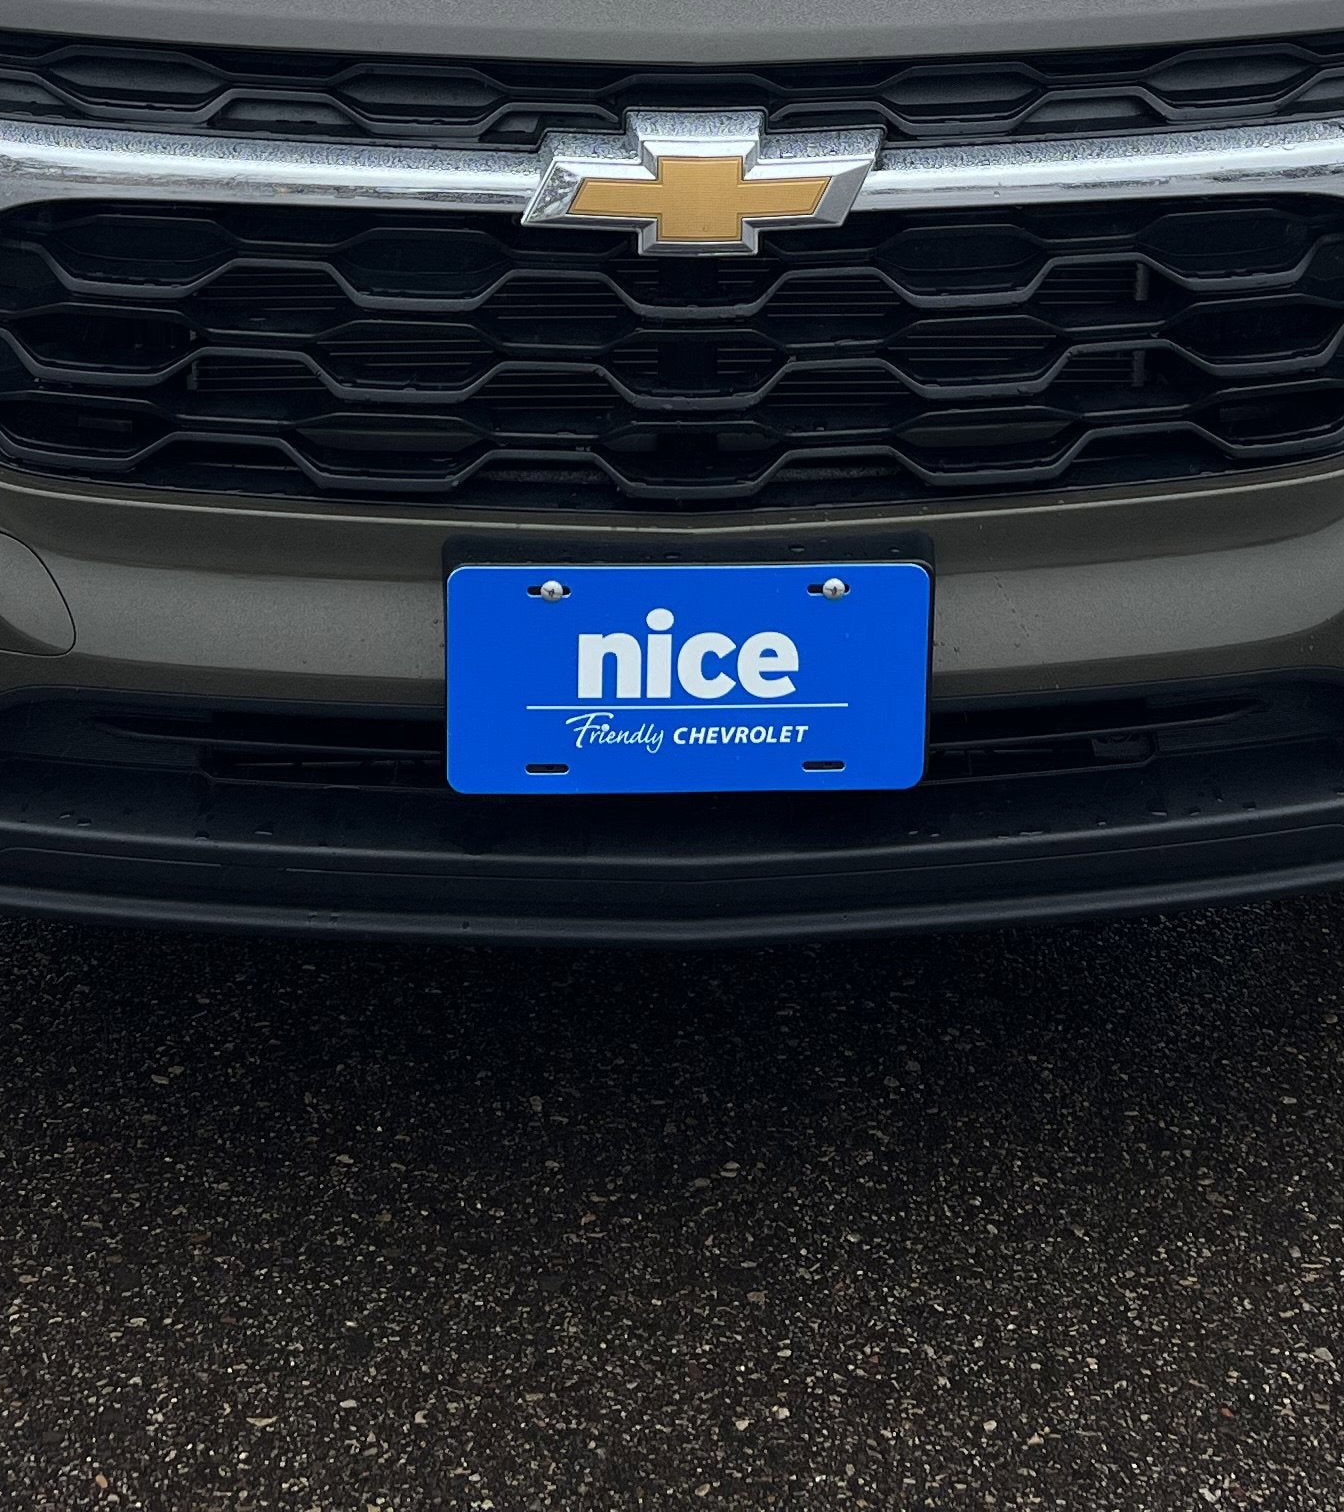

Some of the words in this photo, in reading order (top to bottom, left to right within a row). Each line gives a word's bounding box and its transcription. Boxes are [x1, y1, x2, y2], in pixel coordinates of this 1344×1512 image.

[577, 607, 800, 700] nice
[565, 712, 665, 754] Friendly
[673, 725, 809, 745] CHEVROLET
